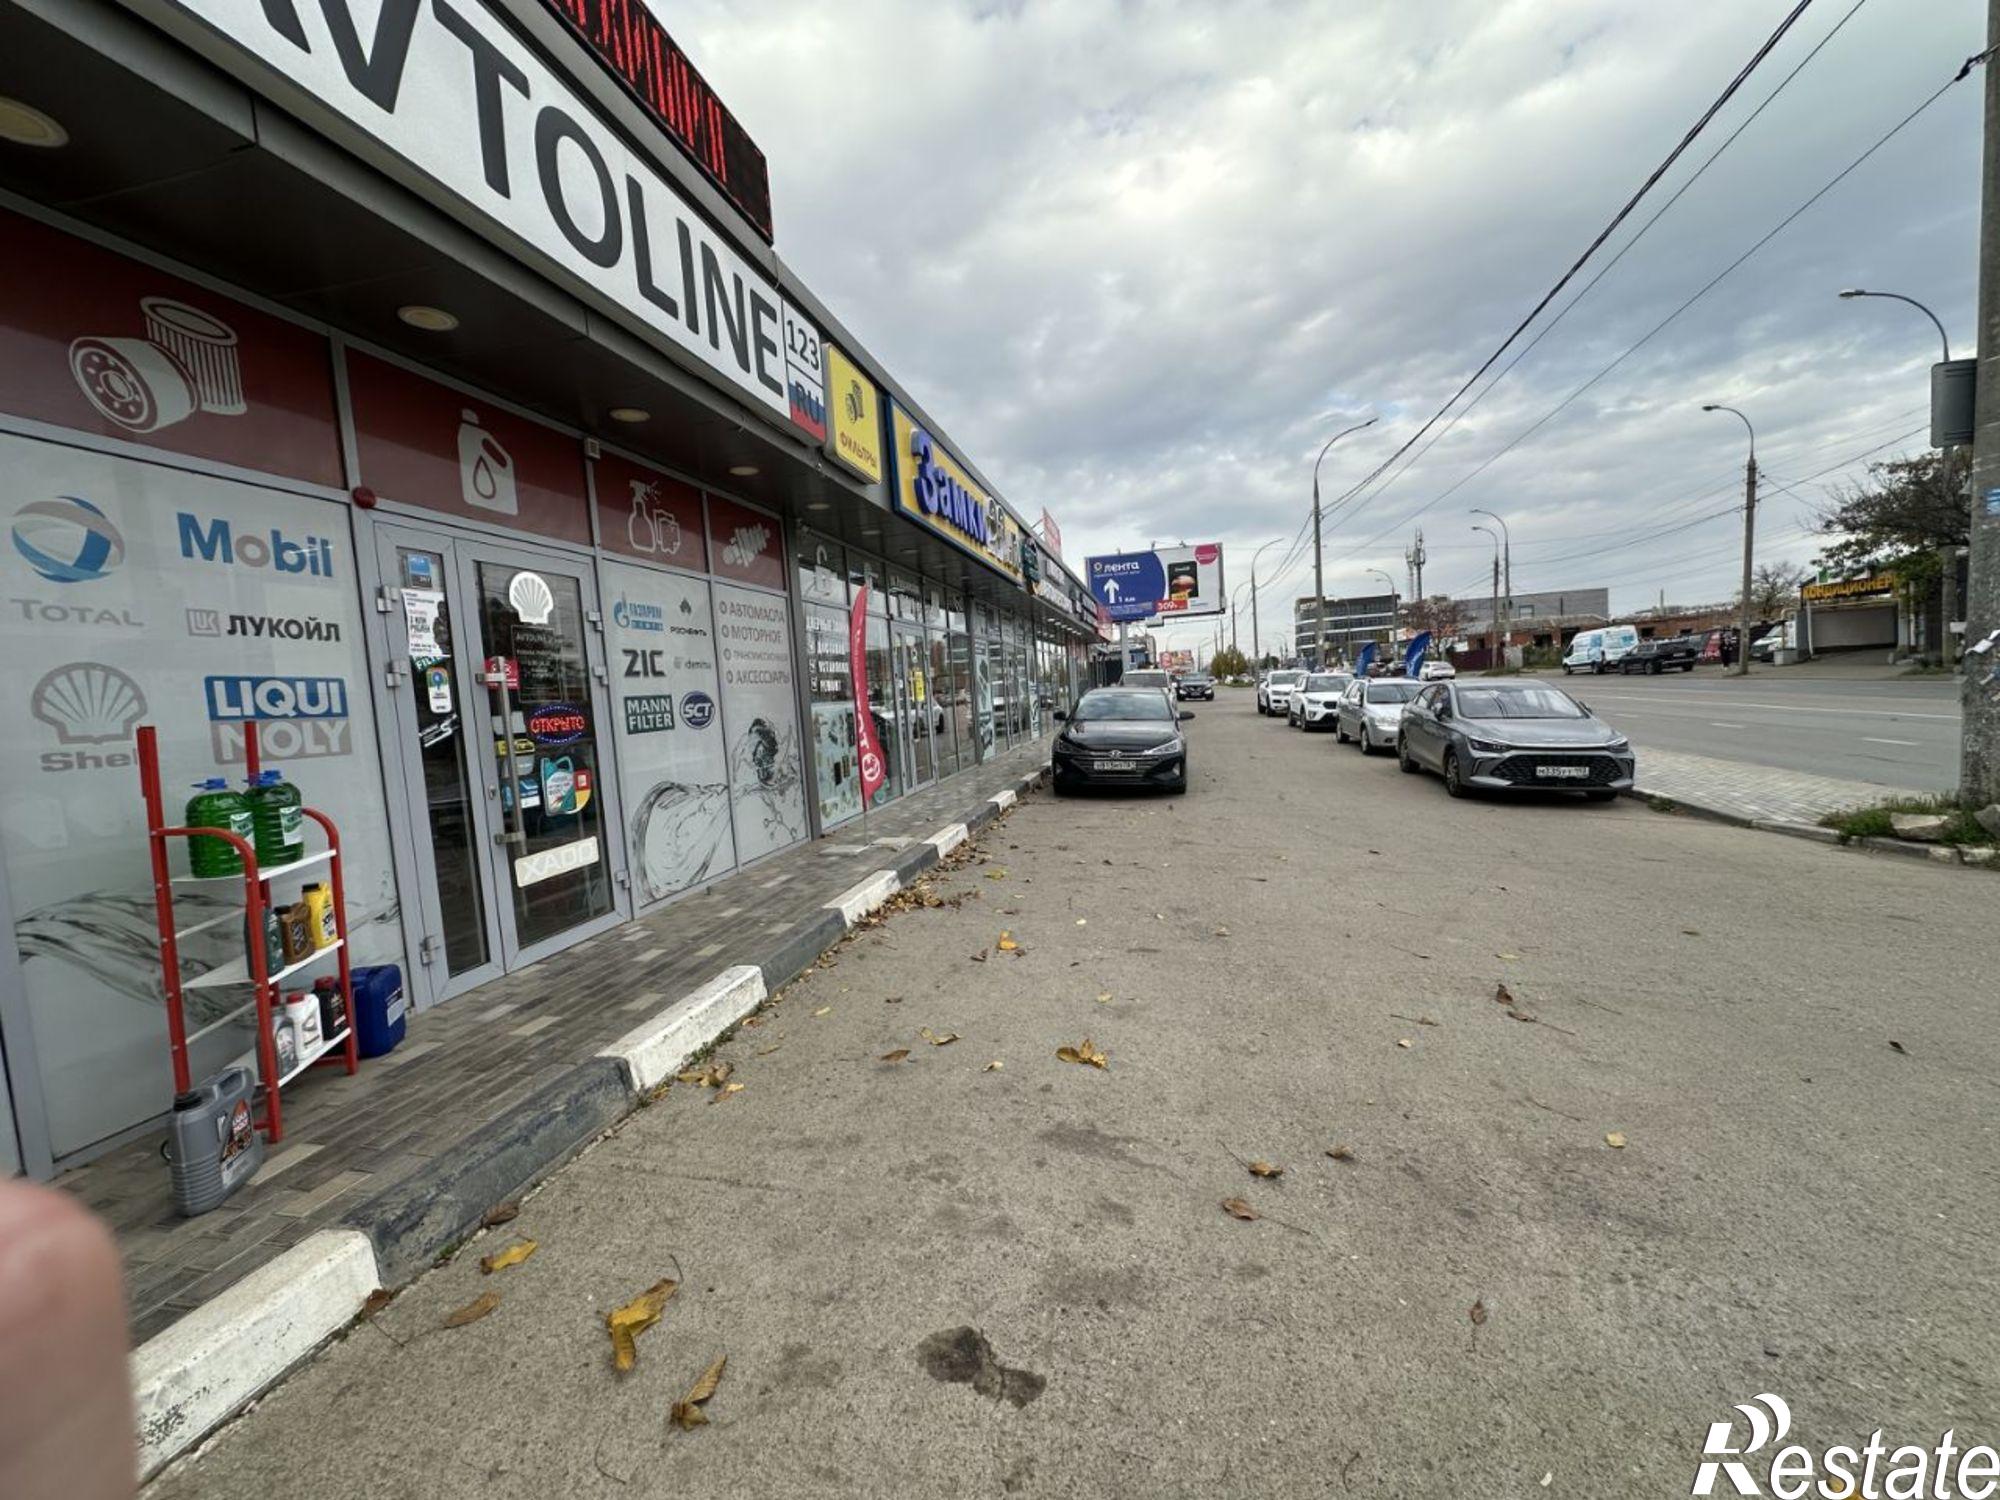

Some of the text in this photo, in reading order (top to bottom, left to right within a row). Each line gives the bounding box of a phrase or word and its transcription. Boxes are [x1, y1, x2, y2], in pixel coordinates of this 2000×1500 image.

[260, 0, 785, 400] VTOLINE
[786, 319, 820, 371] 123
[794, 380, 822, 426] RU
[839, 430, 878, 468] ФИЛЬТРЫ
[176, 511, 334, 578] Mobil
[1105, 561, 1140, 572] лента
[1803, 576, 1900, 600] КОНДИЦИОНЕР
[10, 598, 145, 628] TOTAL
[729, 600, 785, 624] АВТОМАСЛА
[227, 614, 341, 643] ЛУКОЙЛ
[621, 648, 666, 678] ZIC
[212, 678, 343, 718] LIQUI
[627, 698, 671, 715] MANN
[683, 702, 712, 719] SCT
[530, 715, 585, 734] ОТКРЫТО
[628, 712, 674, 732] FILTER
[41, 749, 137, 773] Shel
